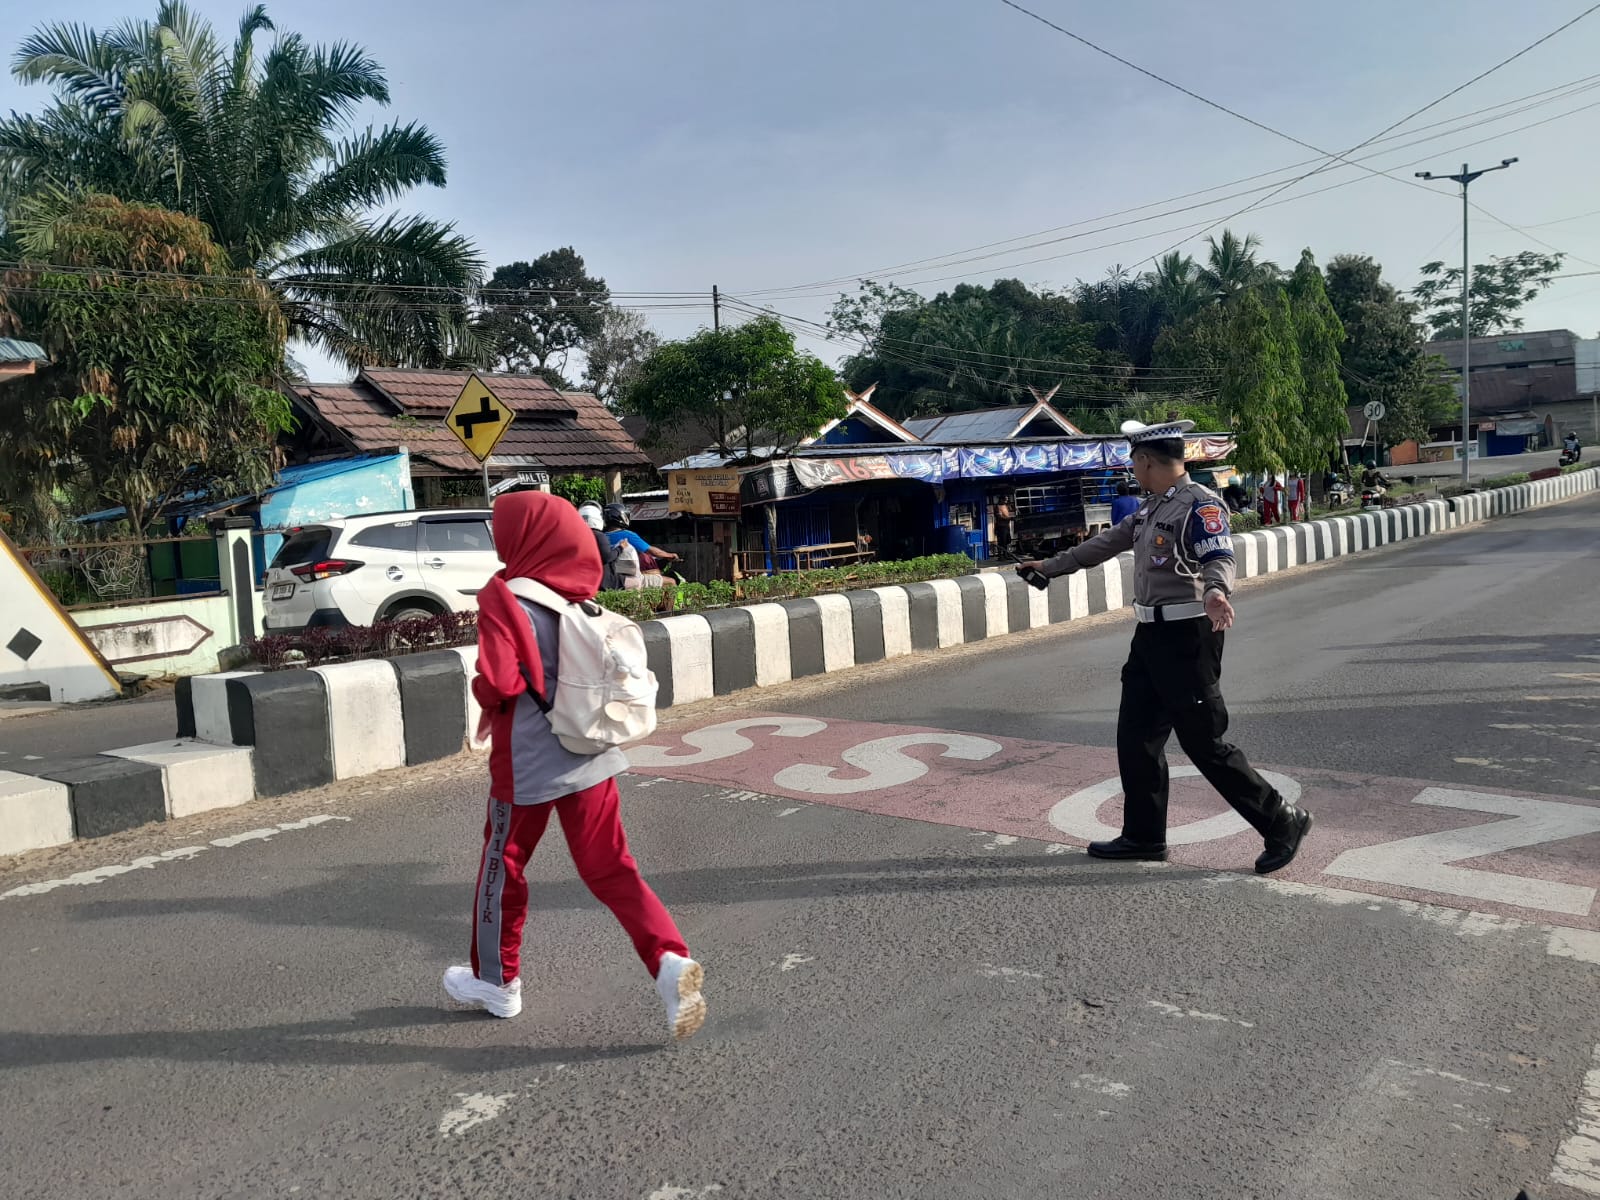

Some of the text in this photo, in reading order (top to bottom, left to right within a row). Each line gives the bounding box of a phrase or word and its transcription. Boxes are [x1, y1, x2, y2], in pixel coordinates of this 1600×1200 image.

[1367, 404, 1380, 416] 30
[519, 472, 547, 482] HALTE
[834, 459, 872, 480] 16
[482, 857, 499, 923] BULIK
